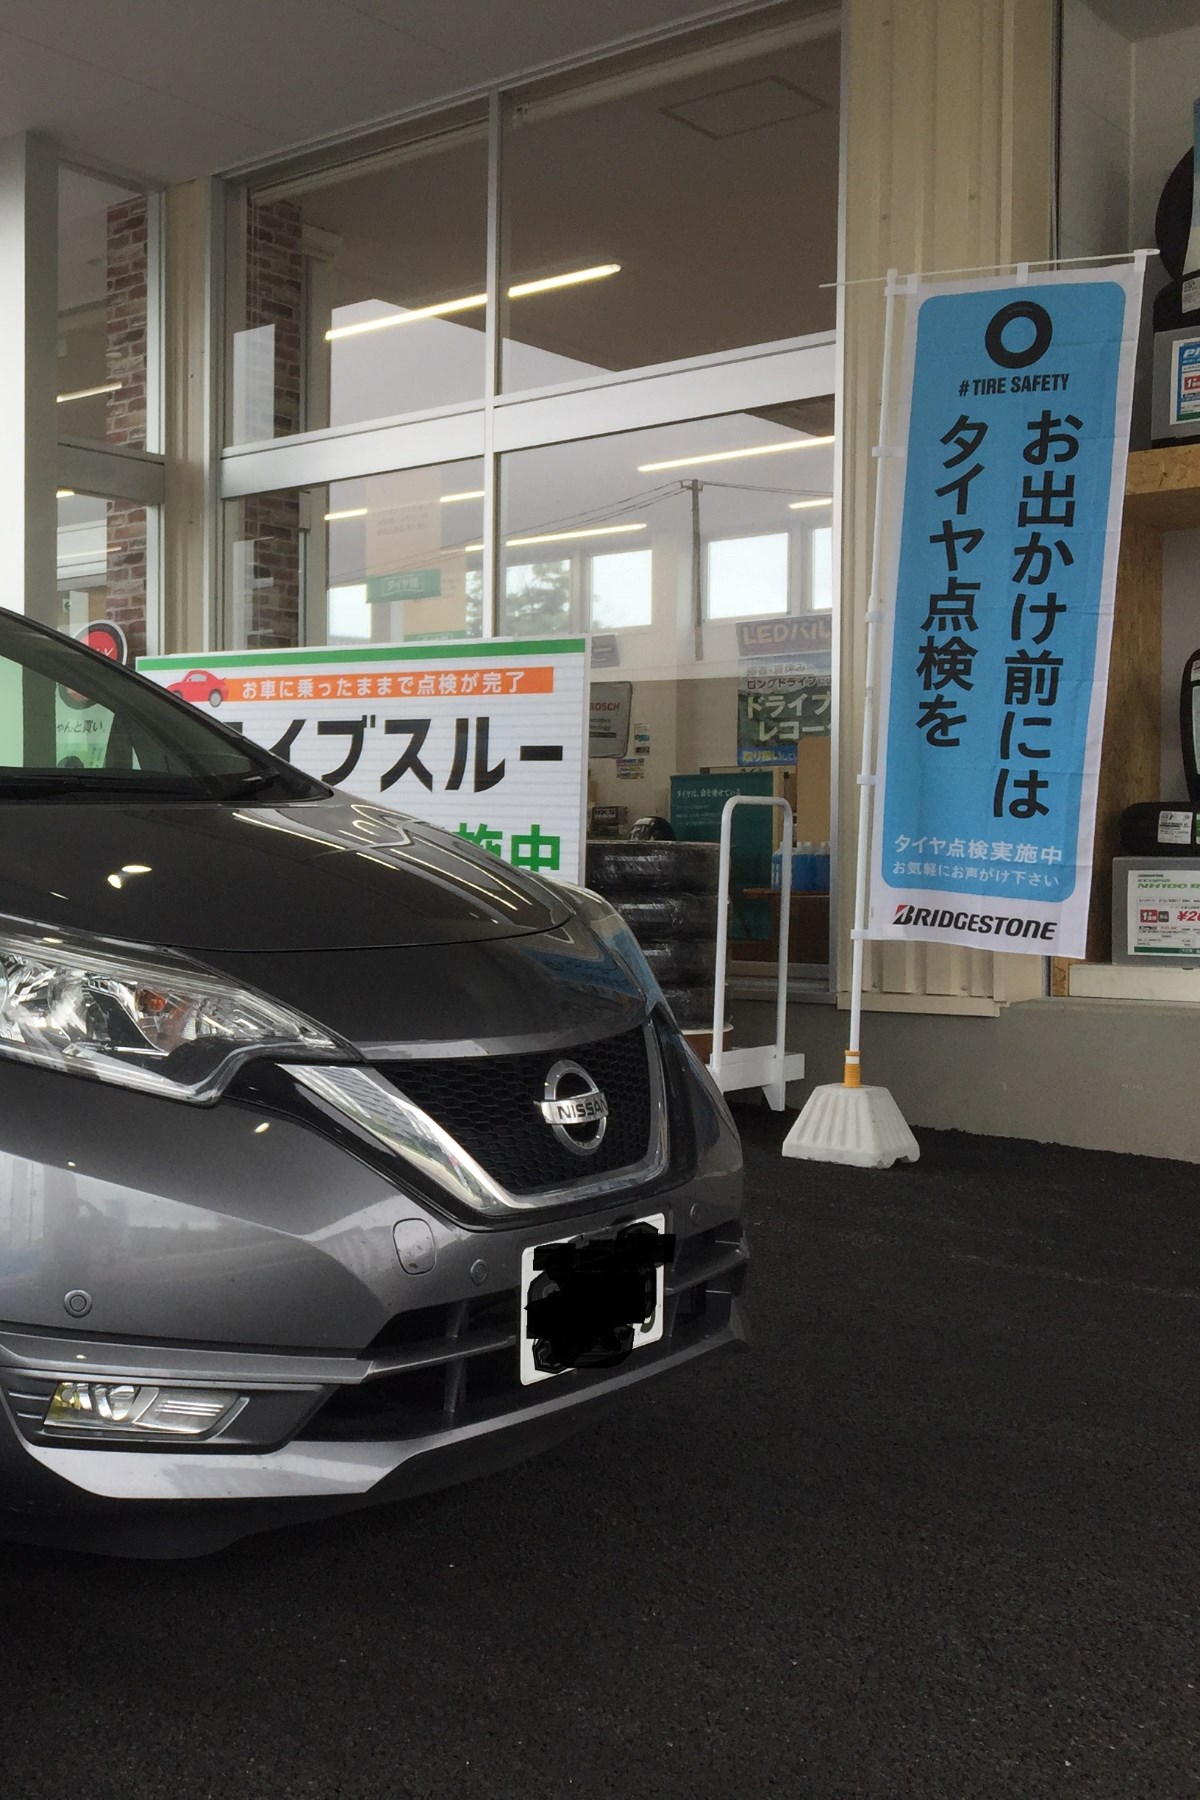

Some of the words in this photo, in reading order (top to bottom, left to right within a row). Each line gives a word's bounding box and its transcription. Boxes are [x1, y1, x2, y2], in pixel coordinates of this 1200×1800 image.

[1010, 373, 1070, 393] SAFETY
[915, 414, 989, 748] タイヤ点検を
[993, 410, 1084, 819] お出かけ前には
[242, 671, 526, 700] お車に乗ったままで点検が完了
[759, 720, 831, 742] レコー
[223, 714, 564, 793] イブスルー
[894, 834, 1063, 866] タイヤ点検実施中
[892, 860, 1060, 888] お気軽にお声がけ下さい
[893, 904, 1058, 940] BRIDGESTONE
[556, 1100, 608, 1120] NISSAN
